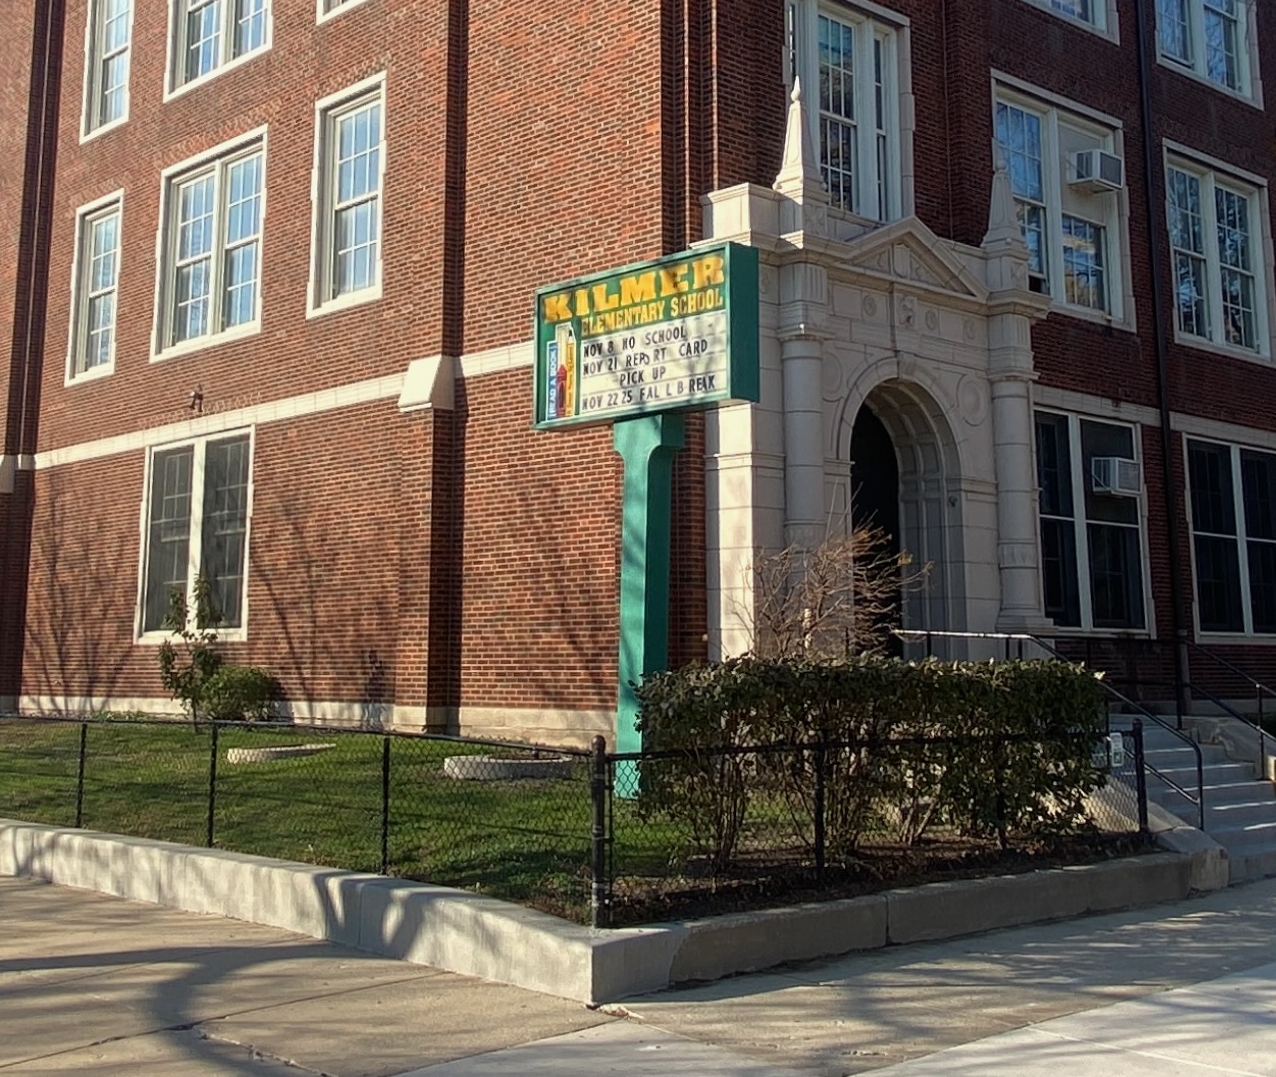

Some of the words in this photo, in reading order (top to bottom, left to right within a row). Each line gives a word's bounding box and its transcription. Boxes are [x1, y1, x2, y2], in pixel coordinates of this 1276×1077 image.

[544, 256, 724, 322] KILMER
[581, 300, 666, 337] ELEMENTARY
[671, 288, 723, 317] SCHOOL
[583, 342, 603, 358] NOV
[607, 340, 614, 354] 8
[622, 335, 636, 351] NO
[644, 325, 687, 346] SCHOOL
[549, 350, 557, 377] BOOK
[583, 360, 603, 376] NOV
[607, 356, 618, 371] 21
[625, 347, 667, 368] REPORT
[678, 339, 708, 357] CARD
[619, 369, 644, 388] PICK
[652, 365, 667, 380] UP
[549, 389, 557, 414] READ
[582, 394, 603, 411] NOV
[607, 392, 619, 406] 22
[621, 390, 632, 404] 25
[639, 383, 672, 401] FALL
